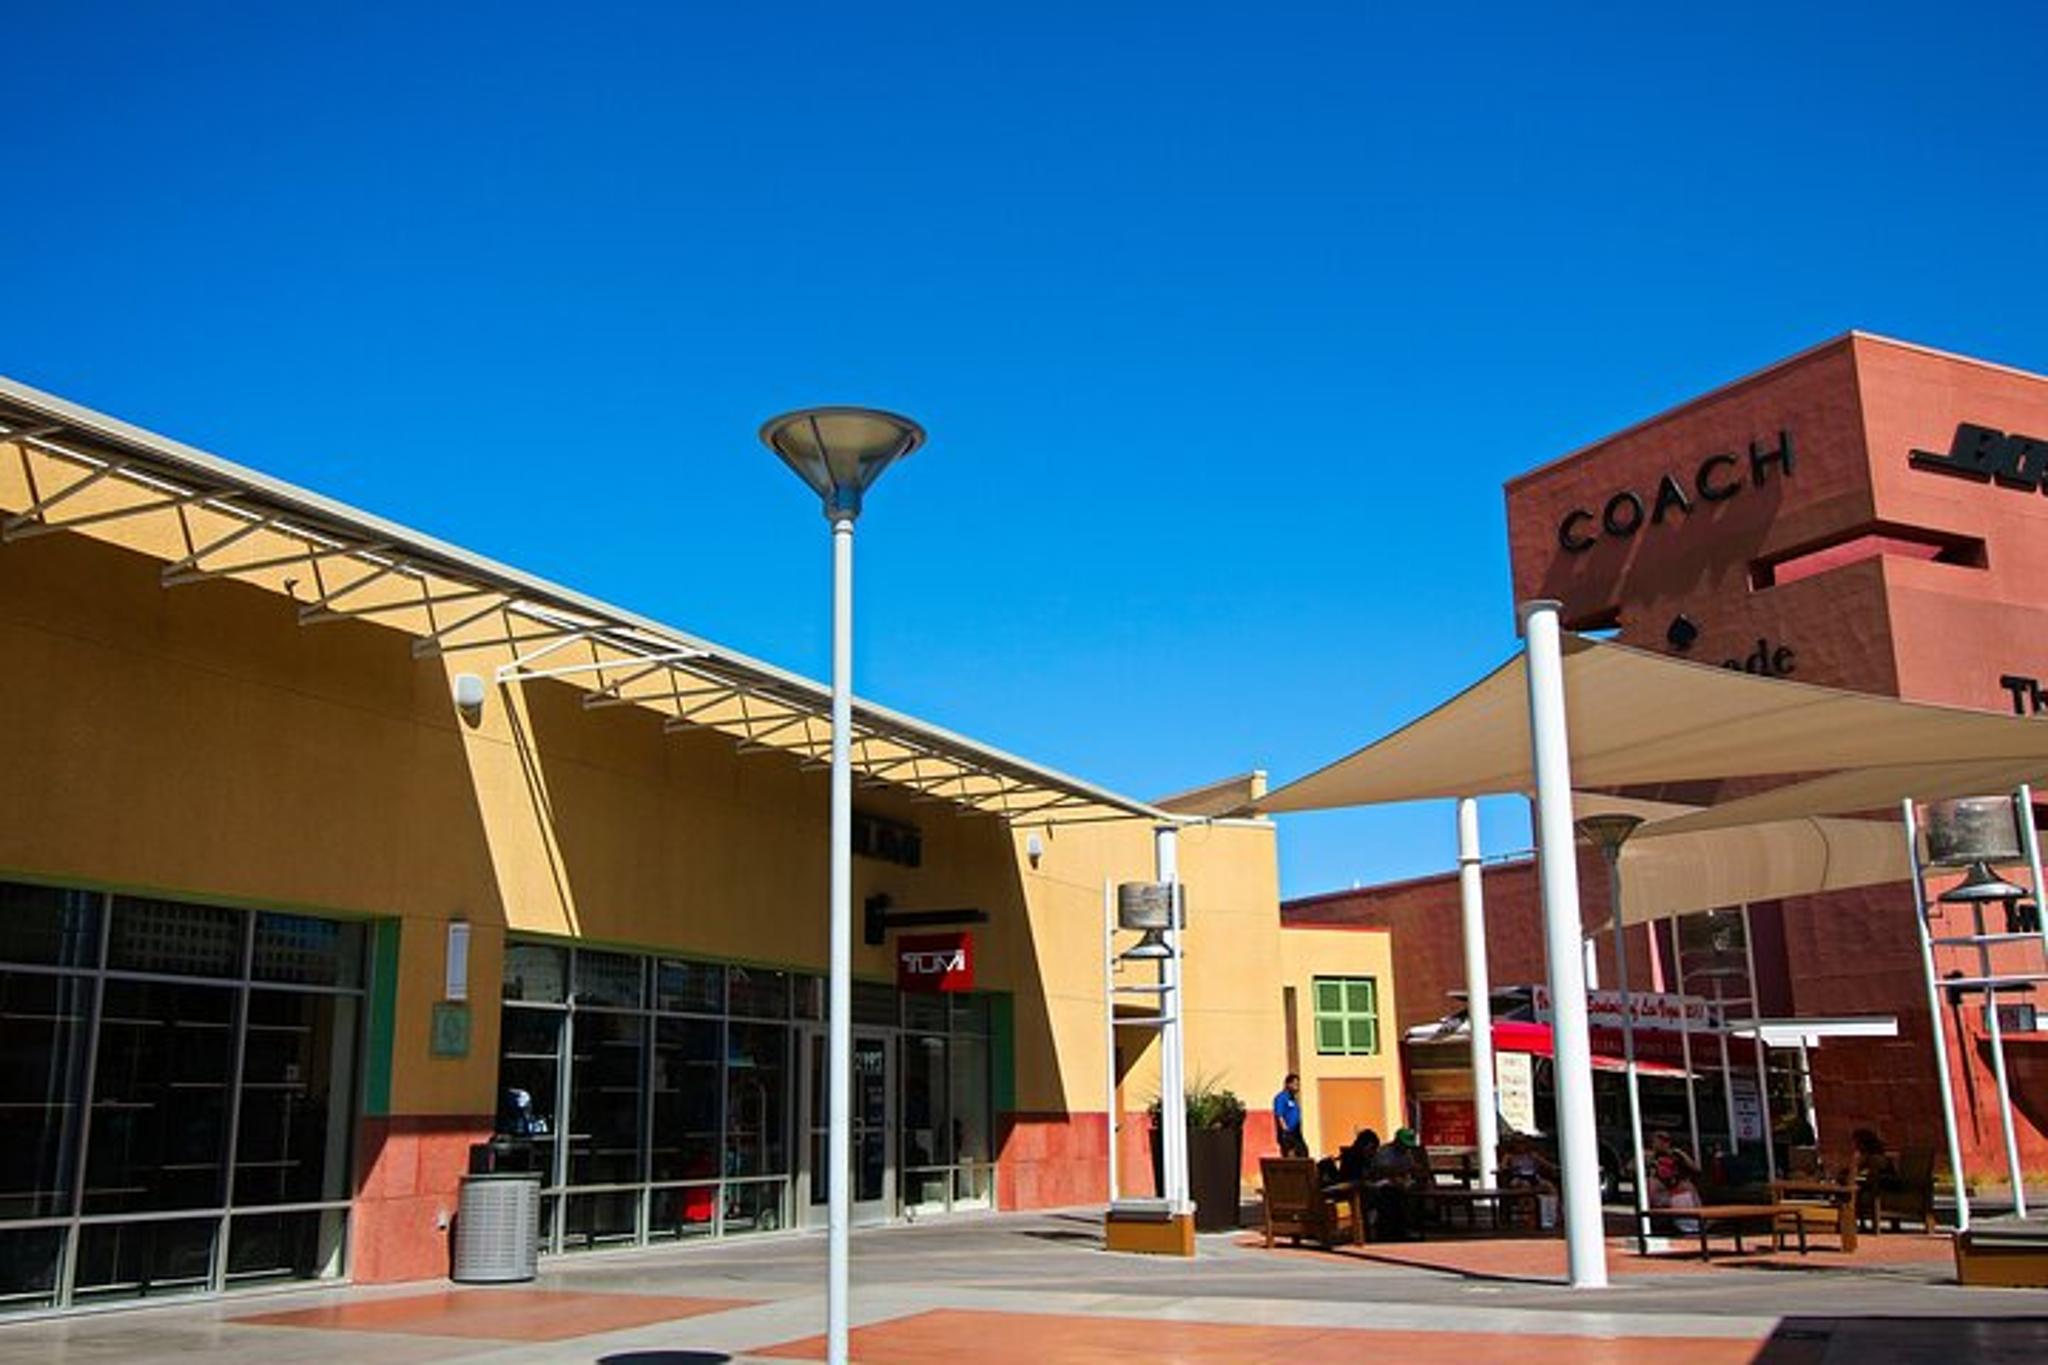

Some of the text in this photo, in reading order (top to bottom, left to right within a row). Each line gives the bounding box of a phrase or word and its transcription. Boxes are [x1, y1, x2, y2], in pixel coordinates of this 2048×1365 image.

[1558, 430, 1794, 551] COACH
[1909, 421, 2048, 497] BO
[901, 949, 966, 974] TUMI
